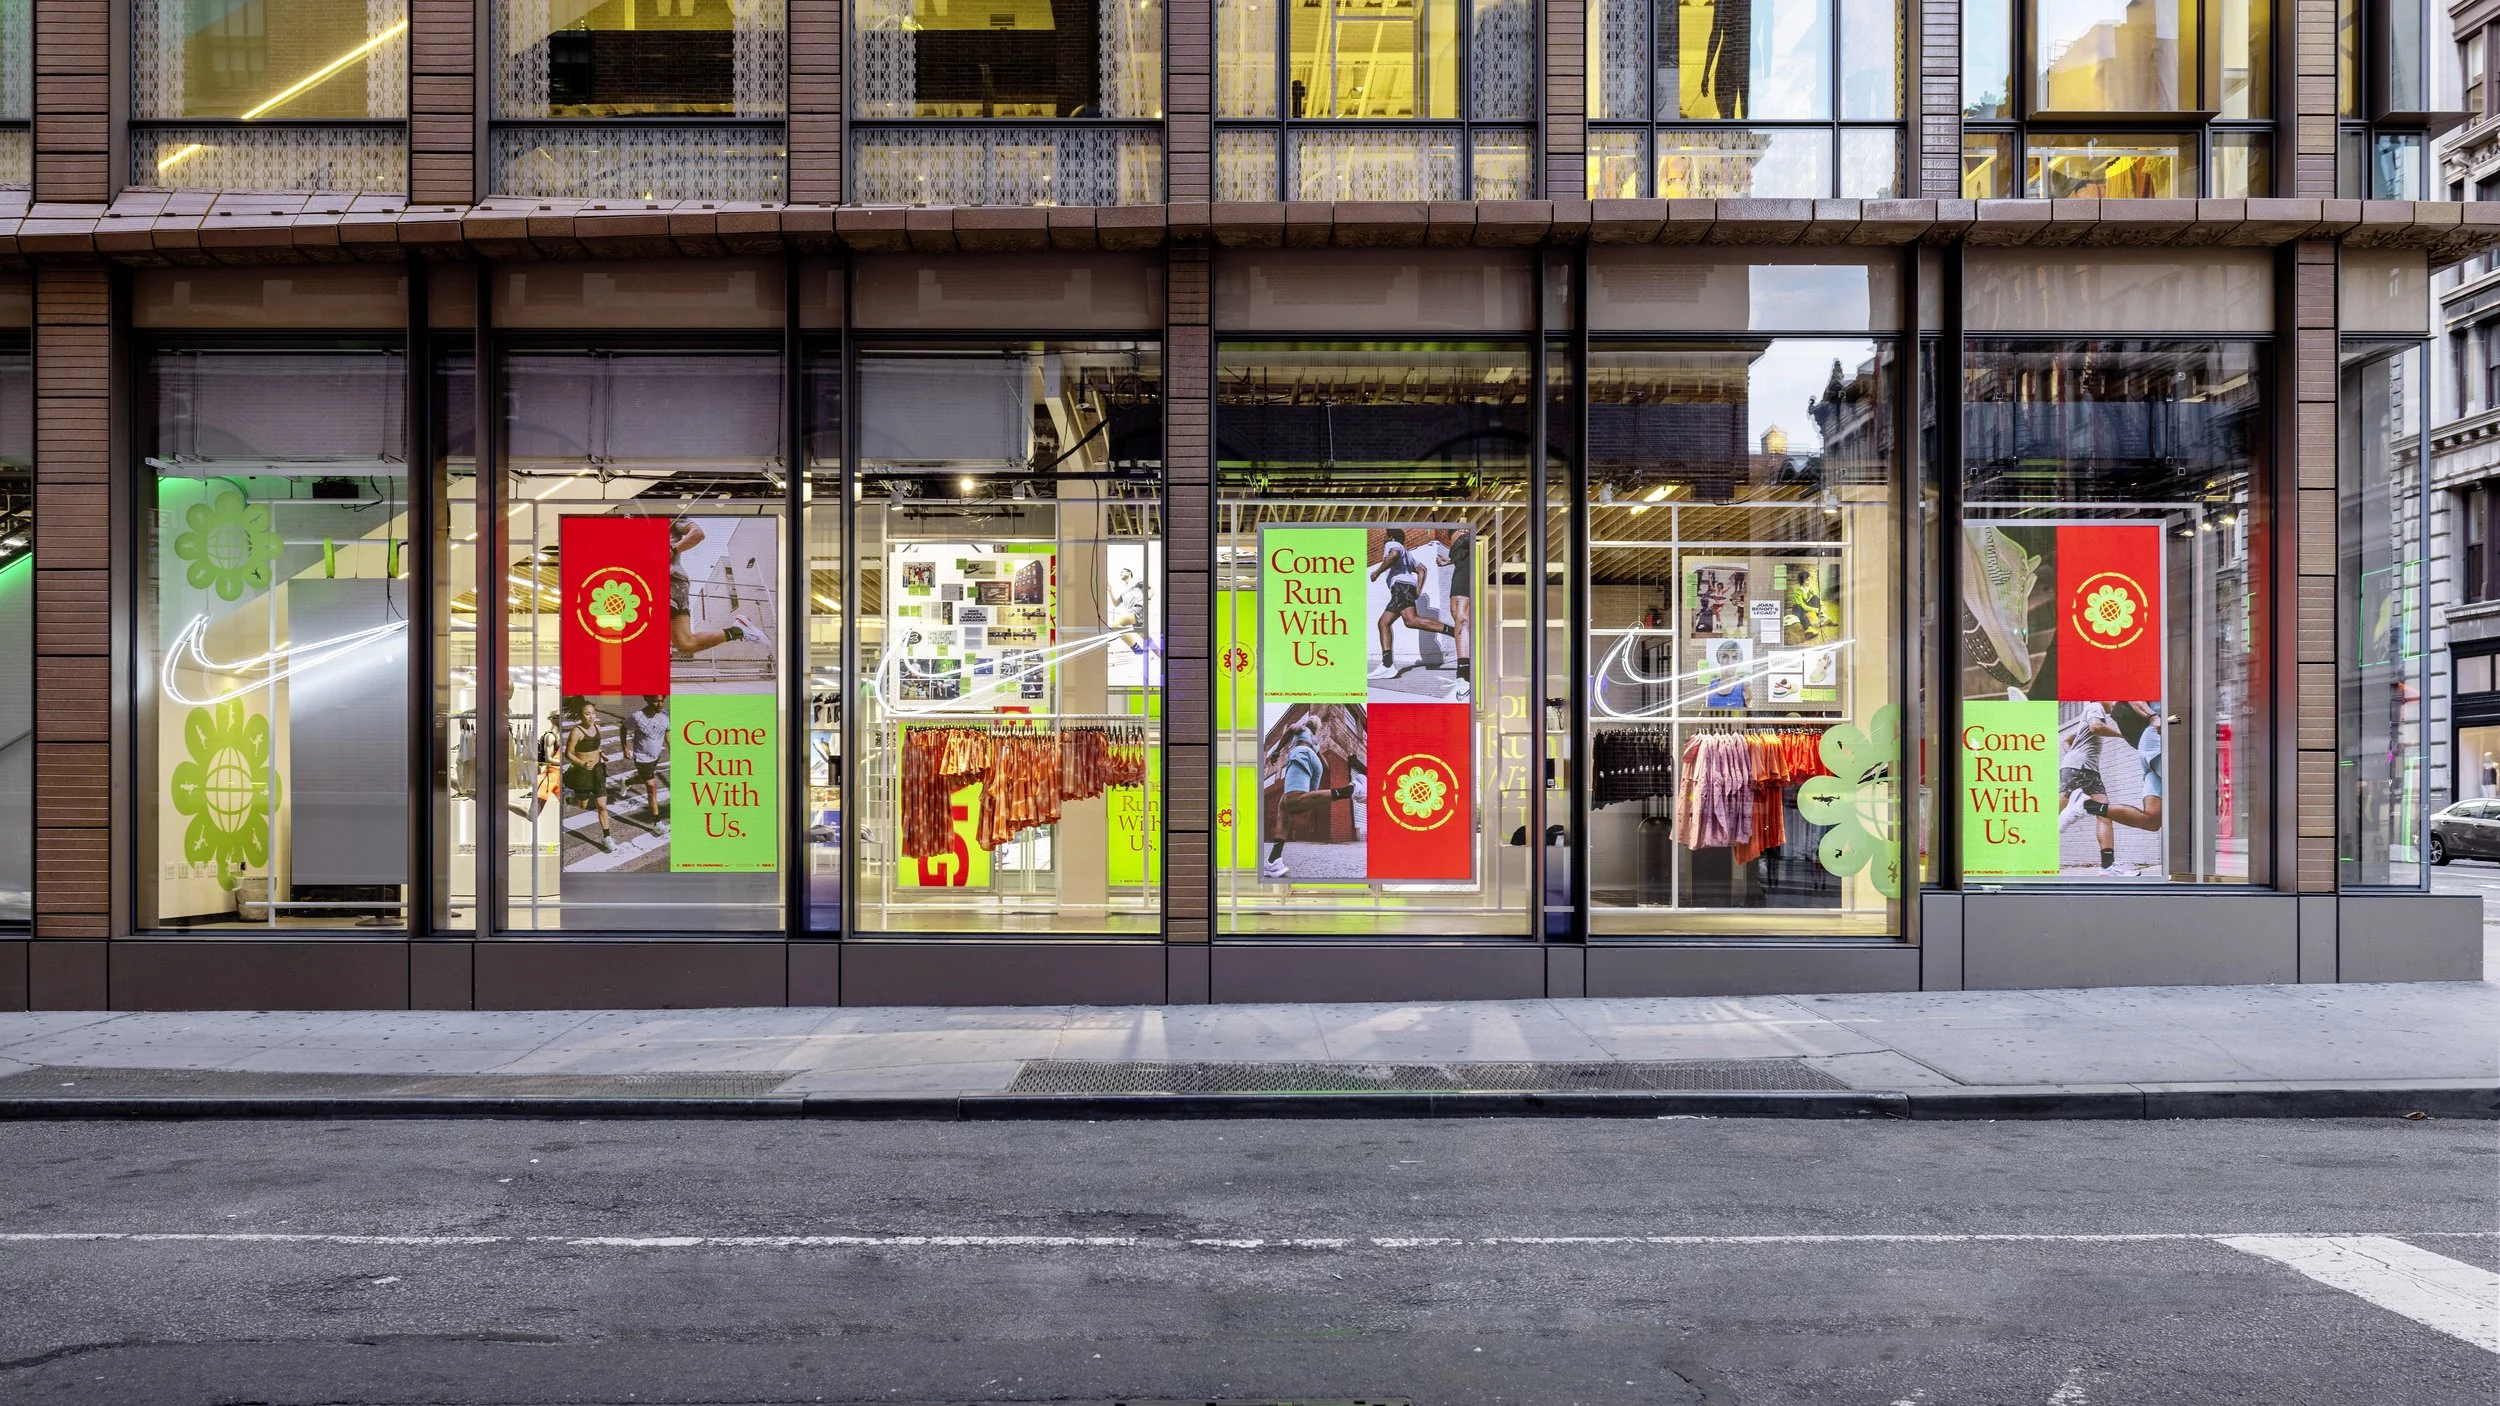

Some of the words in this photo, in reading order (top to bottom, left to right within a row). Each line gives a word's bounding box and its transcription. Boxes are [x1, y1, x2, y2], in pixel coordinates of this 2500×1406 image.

[1271, 548, 1355, 574] Come
[1284, 580, 1341, 604] Run
[1279, 610, 1348, 635] With
[1293, 641, 1335, 666] Us.
[682, 720, 767, 746] Come
[1963, 726, 2046, 752] Come
[696, 751, 753, 776] Run
[1975, 756, 2033, 782] Run
[690, 781, 760, 806] With
[1970, 787, 2039, 813] With
[705, 812, 747, 838] Us.
[1984, 819, 2027, 845] Us.
